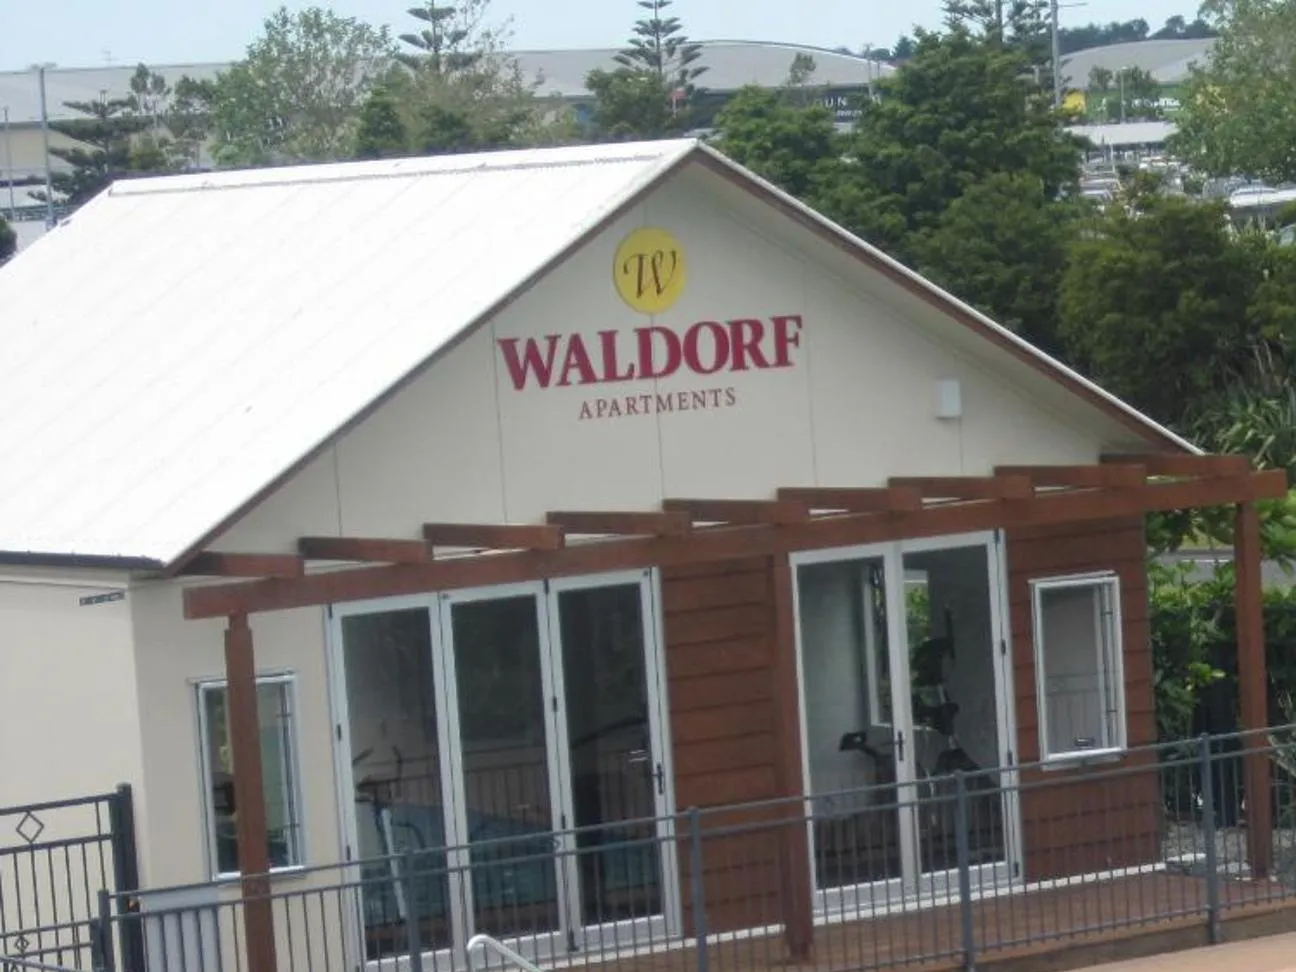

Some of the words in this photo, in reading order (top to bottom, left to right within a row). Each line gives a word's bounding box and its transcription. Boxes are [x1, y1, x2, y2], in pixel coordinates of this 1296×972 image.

[623, 249, 677, 299] W
[498, 315, 803, 391] WALDORF
[578, 387, 737, 420] APARTMENTS
